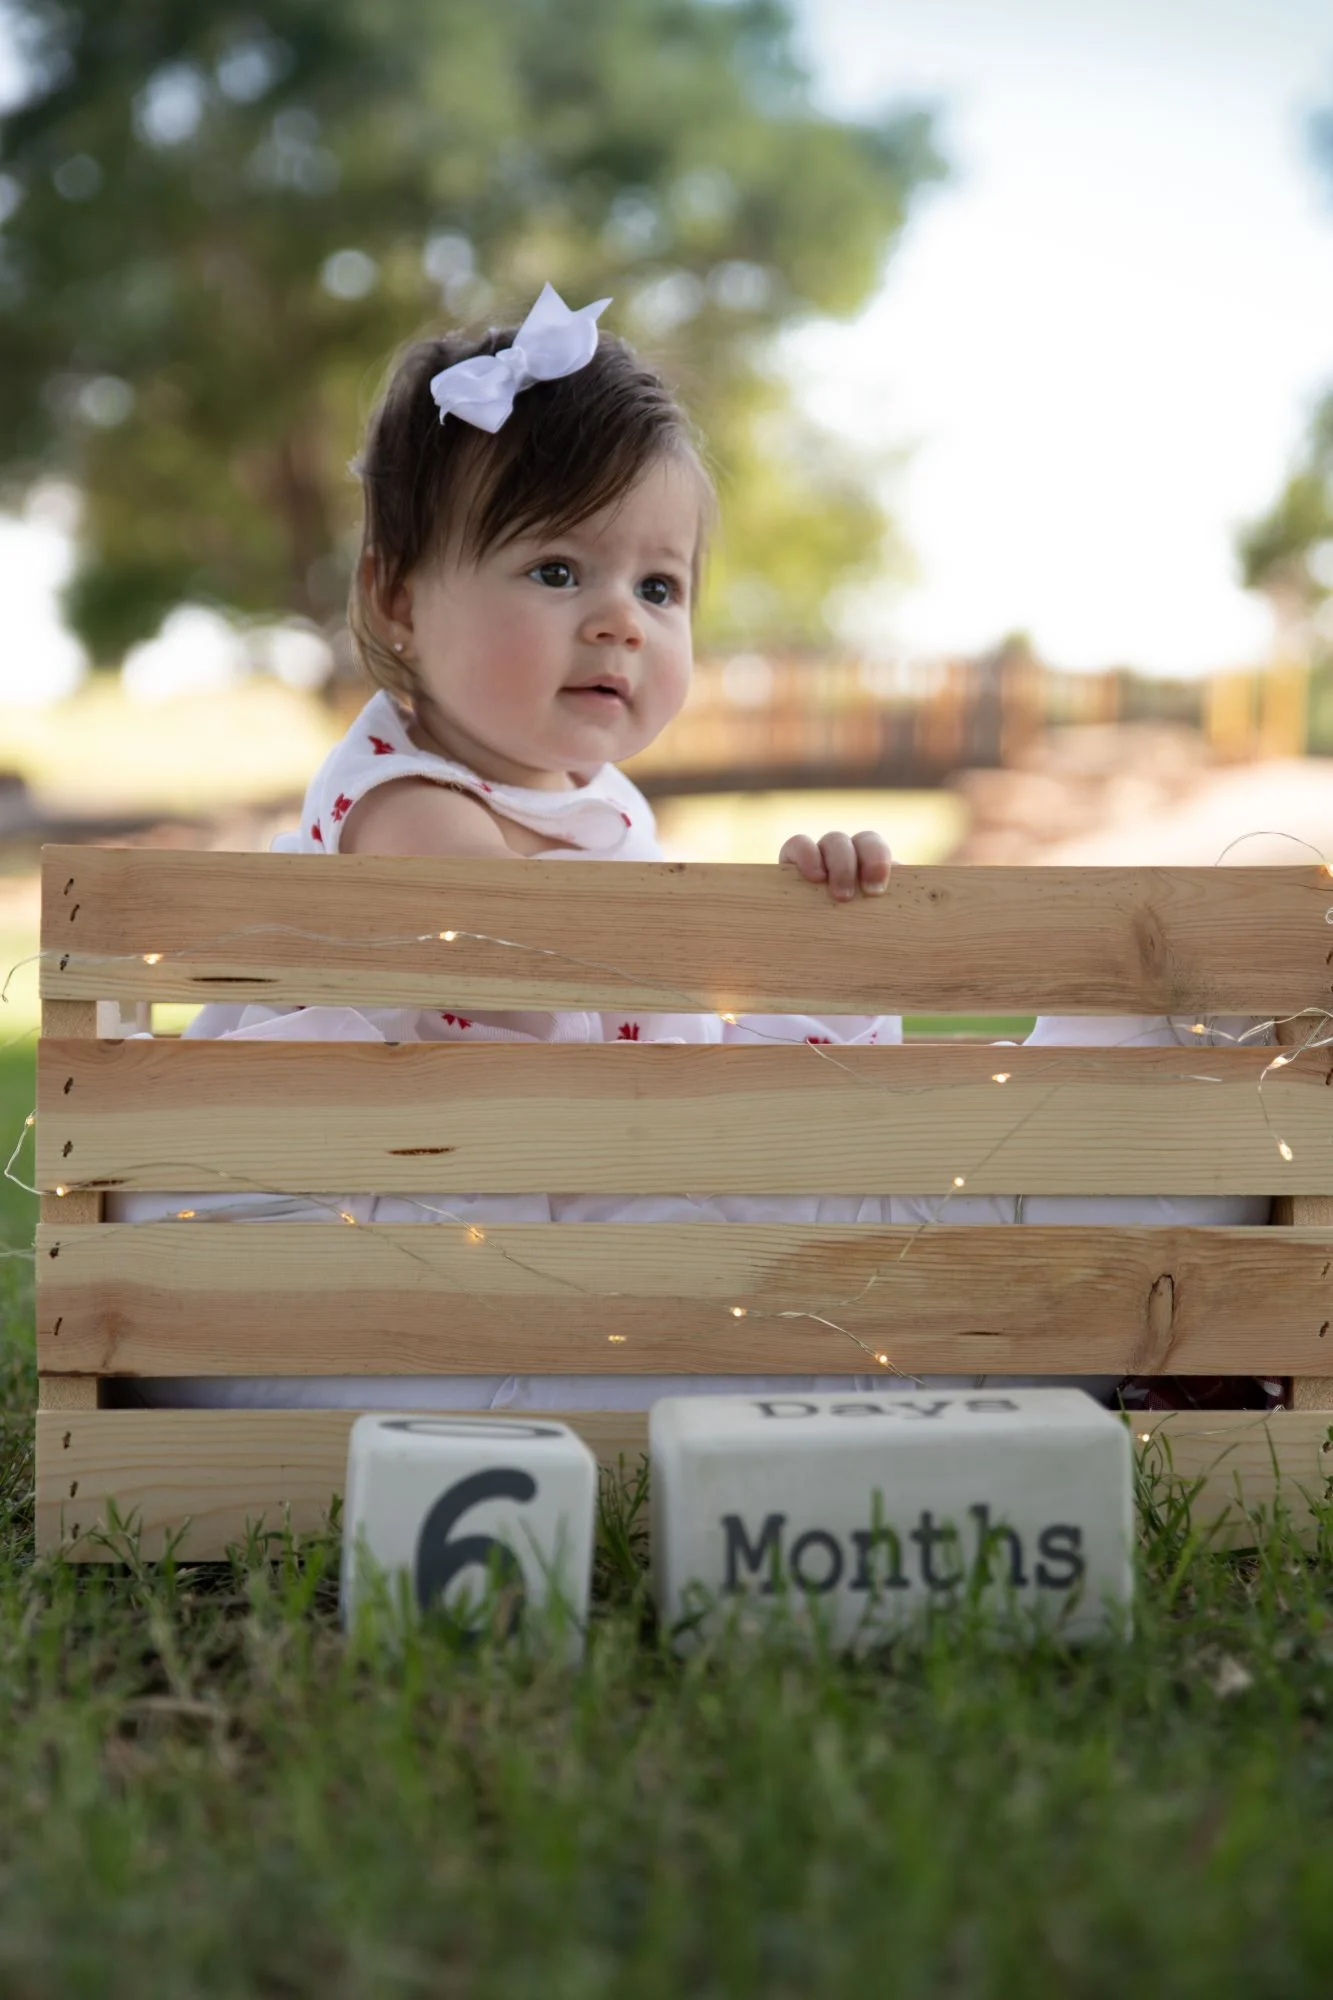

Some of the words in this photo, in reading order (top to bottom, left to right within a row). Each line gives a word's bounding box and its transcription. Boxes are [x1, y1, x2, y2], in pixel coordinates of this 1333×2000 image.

[752, 1398, 1020, 1420] Days
[415, 1467, 537, 1643] 6
[720, 1503, 1086, 1594] Months
